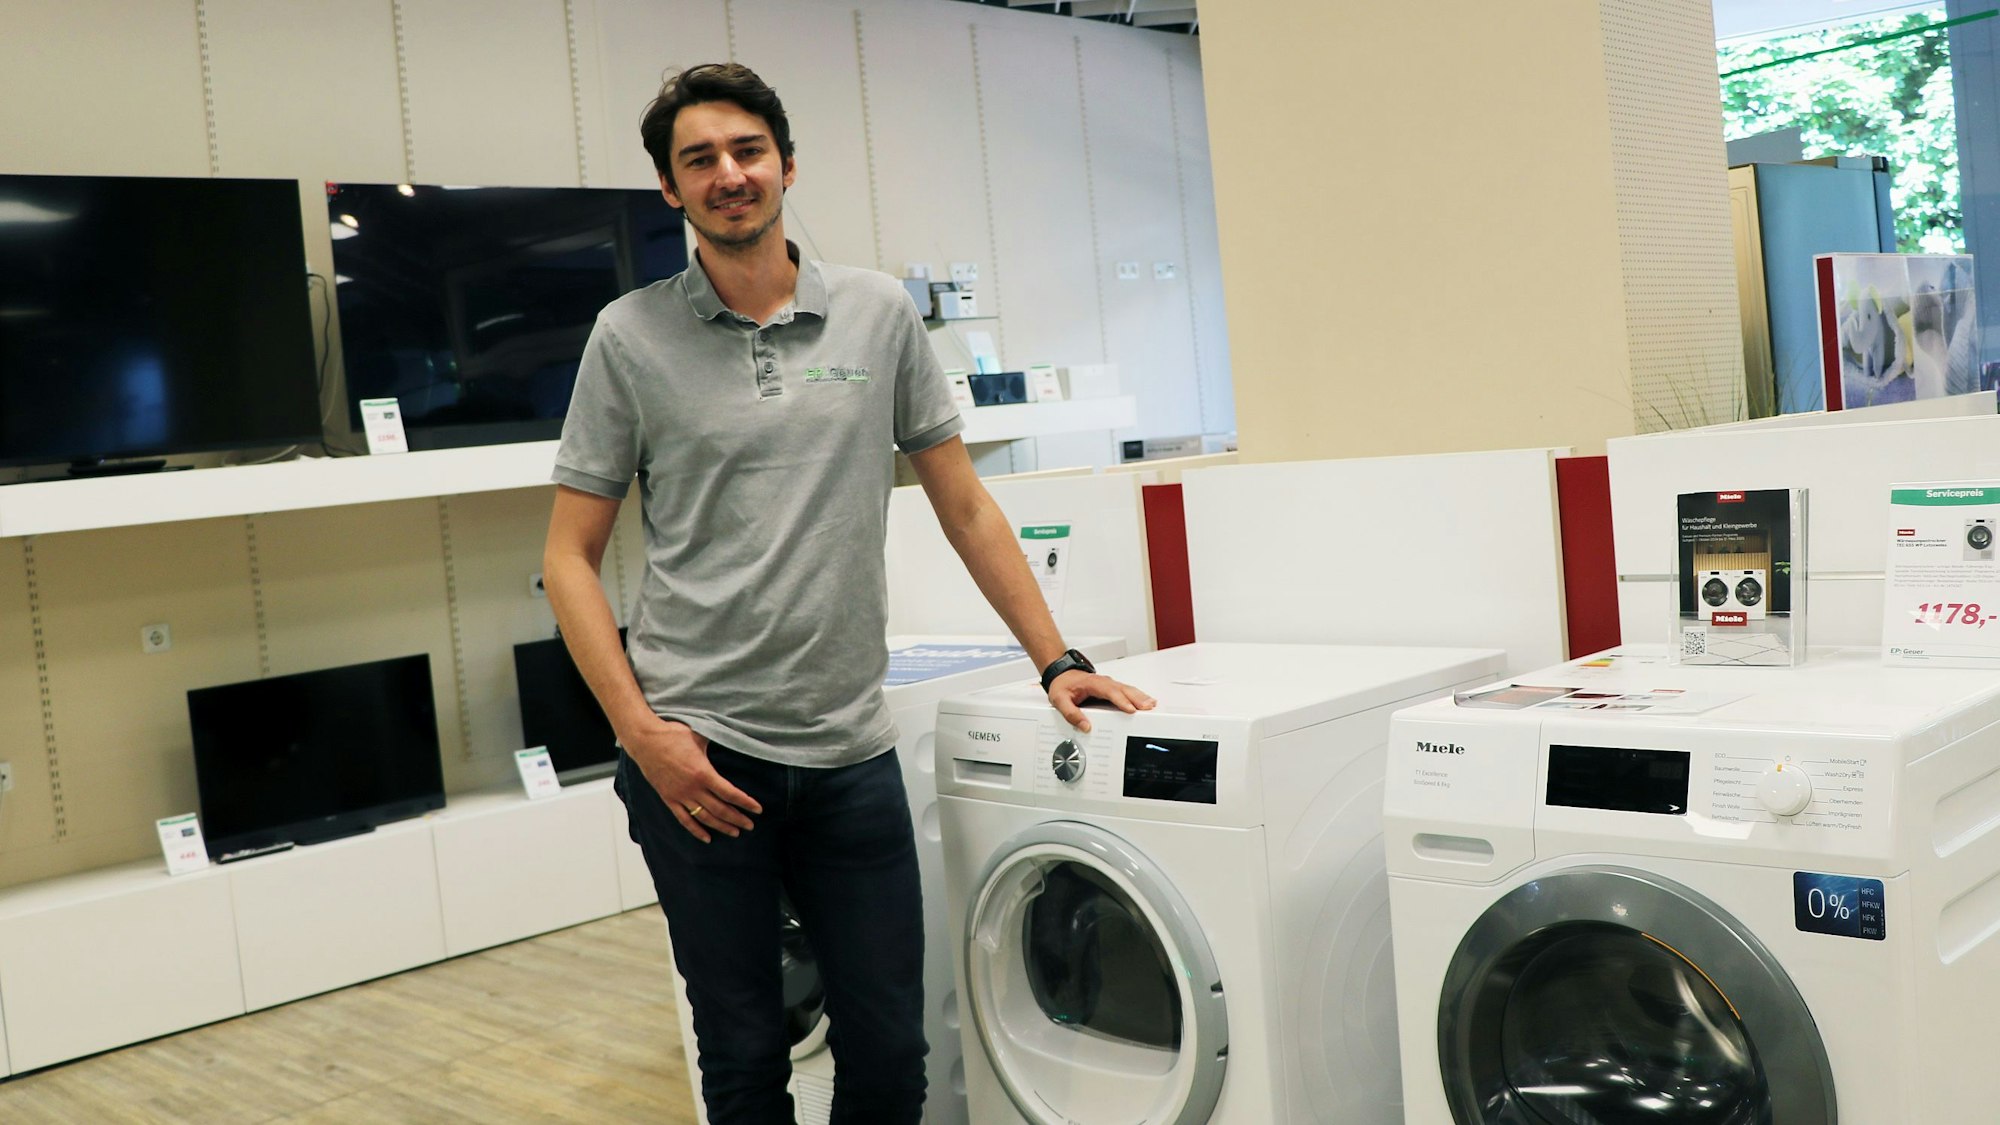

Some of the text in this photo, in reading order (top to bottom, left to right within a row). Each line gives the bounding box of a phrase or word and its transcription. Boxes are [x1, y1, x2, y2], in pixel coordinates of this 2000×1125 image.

[1926, 488, 1984, 499] Servicepreis
[968, 730, 1001, 742] SIEMENS
[1416, 741, 1465, 755] Miele
[1842, 785, 1864, 793] Express
[1861, 887, 1875, 896] HFC
[1807, 888, 1850, 920] 0%
[1861, 900, 1881, 910] HFKW
[1862, 914, 1876, 922] HFK
